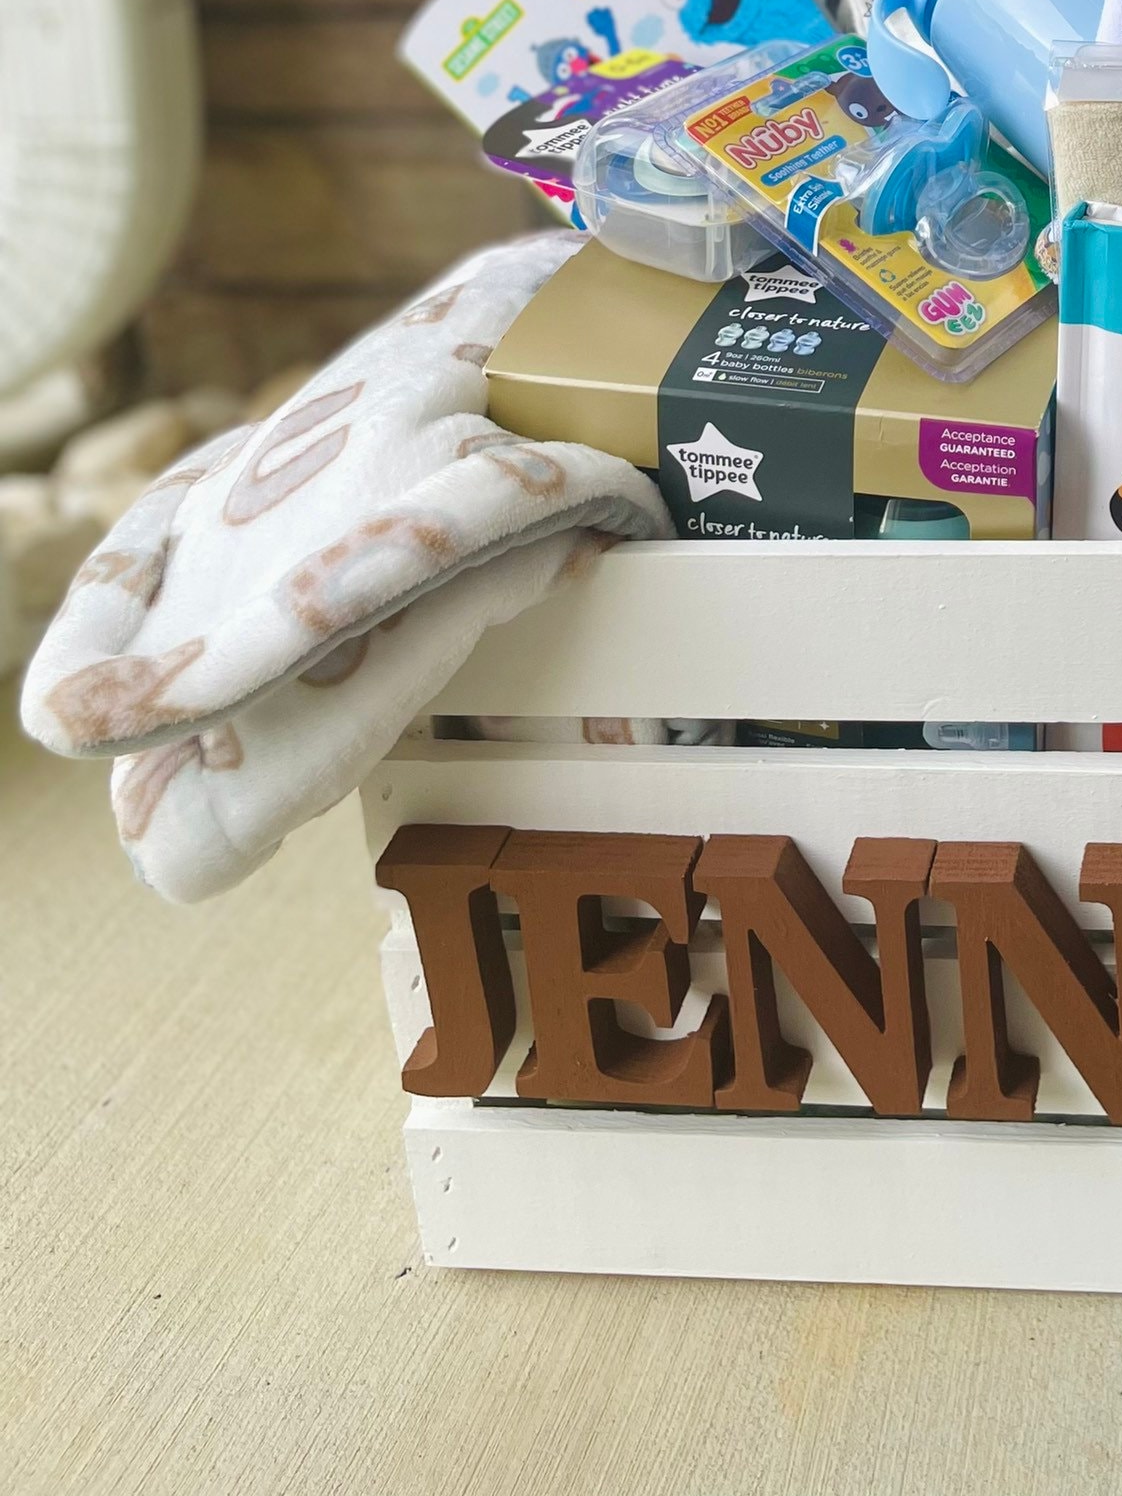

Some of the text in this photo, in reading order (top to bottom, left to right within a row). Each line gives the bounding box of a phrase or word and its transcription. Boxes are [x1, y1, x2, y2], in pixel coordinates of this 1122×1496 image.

[768, 138, 839, 183] Soothing Teether
[749, 274, 820, 289] tommee
[754, 281, 810, 296] tippee
[919, 281, 974, 324] GUM
[728, 306, 871, 332] closer to nature
[945, 302, 985, 335] EEZ
[701, 351, 848, 380] 4 baby bottles biberons
[725, 352, 781, 363] 9oz 260ml
[728, 374, 749, 383] slow
[750, 377, 771, 385] flow
[940, 428, 1016, 447] Acceptance
[679, 448, 754, 469] tommee
[939, 442, 1016, 459] GUARANTEED
[689, 465, 749, 485] tippee
[940, 459, 1017, 476] Acceptation
[951, 473, 1009, 487] GARANTIE
[687, 512, 745, 537] closer
[748, 522, 767, 540] to
